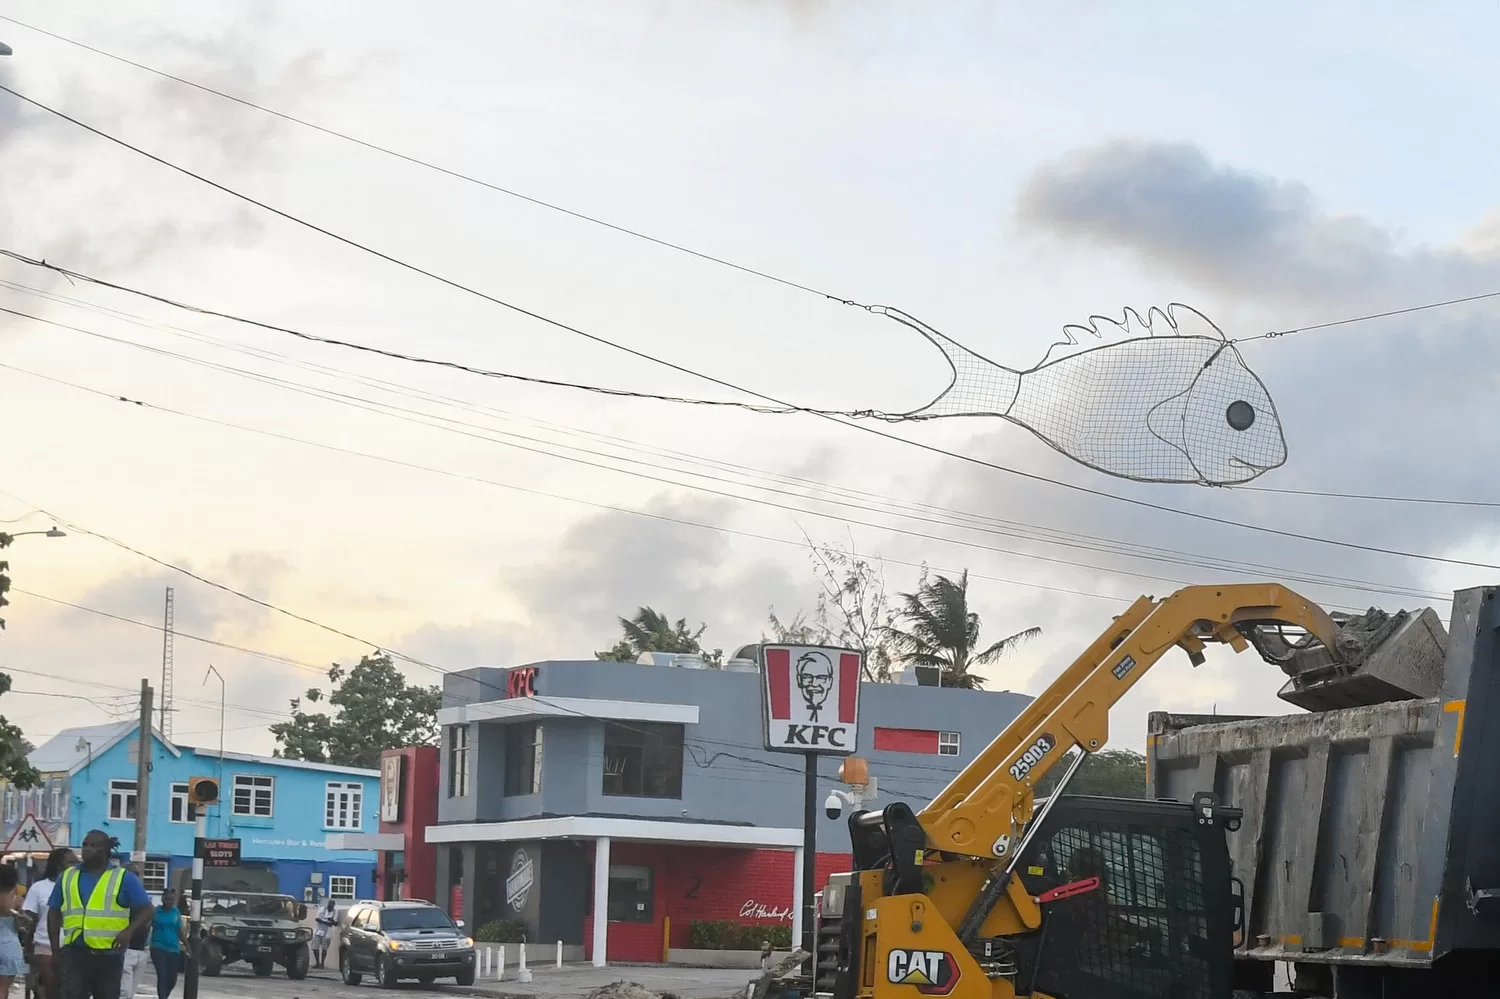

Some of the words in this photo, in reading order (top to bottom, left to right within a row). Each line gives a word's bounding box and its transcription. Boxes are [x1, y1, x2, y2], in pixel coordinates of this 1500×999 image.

[506, 667, 535, 699] KFC
[784, 724, 846, 747] KFC
[1010, 738, 1051, 781] 259D3
[252, 837, 285, 845] Hercules
[286, 838, 300, 846] Bar
[888, 949, 944, 985] CAT
